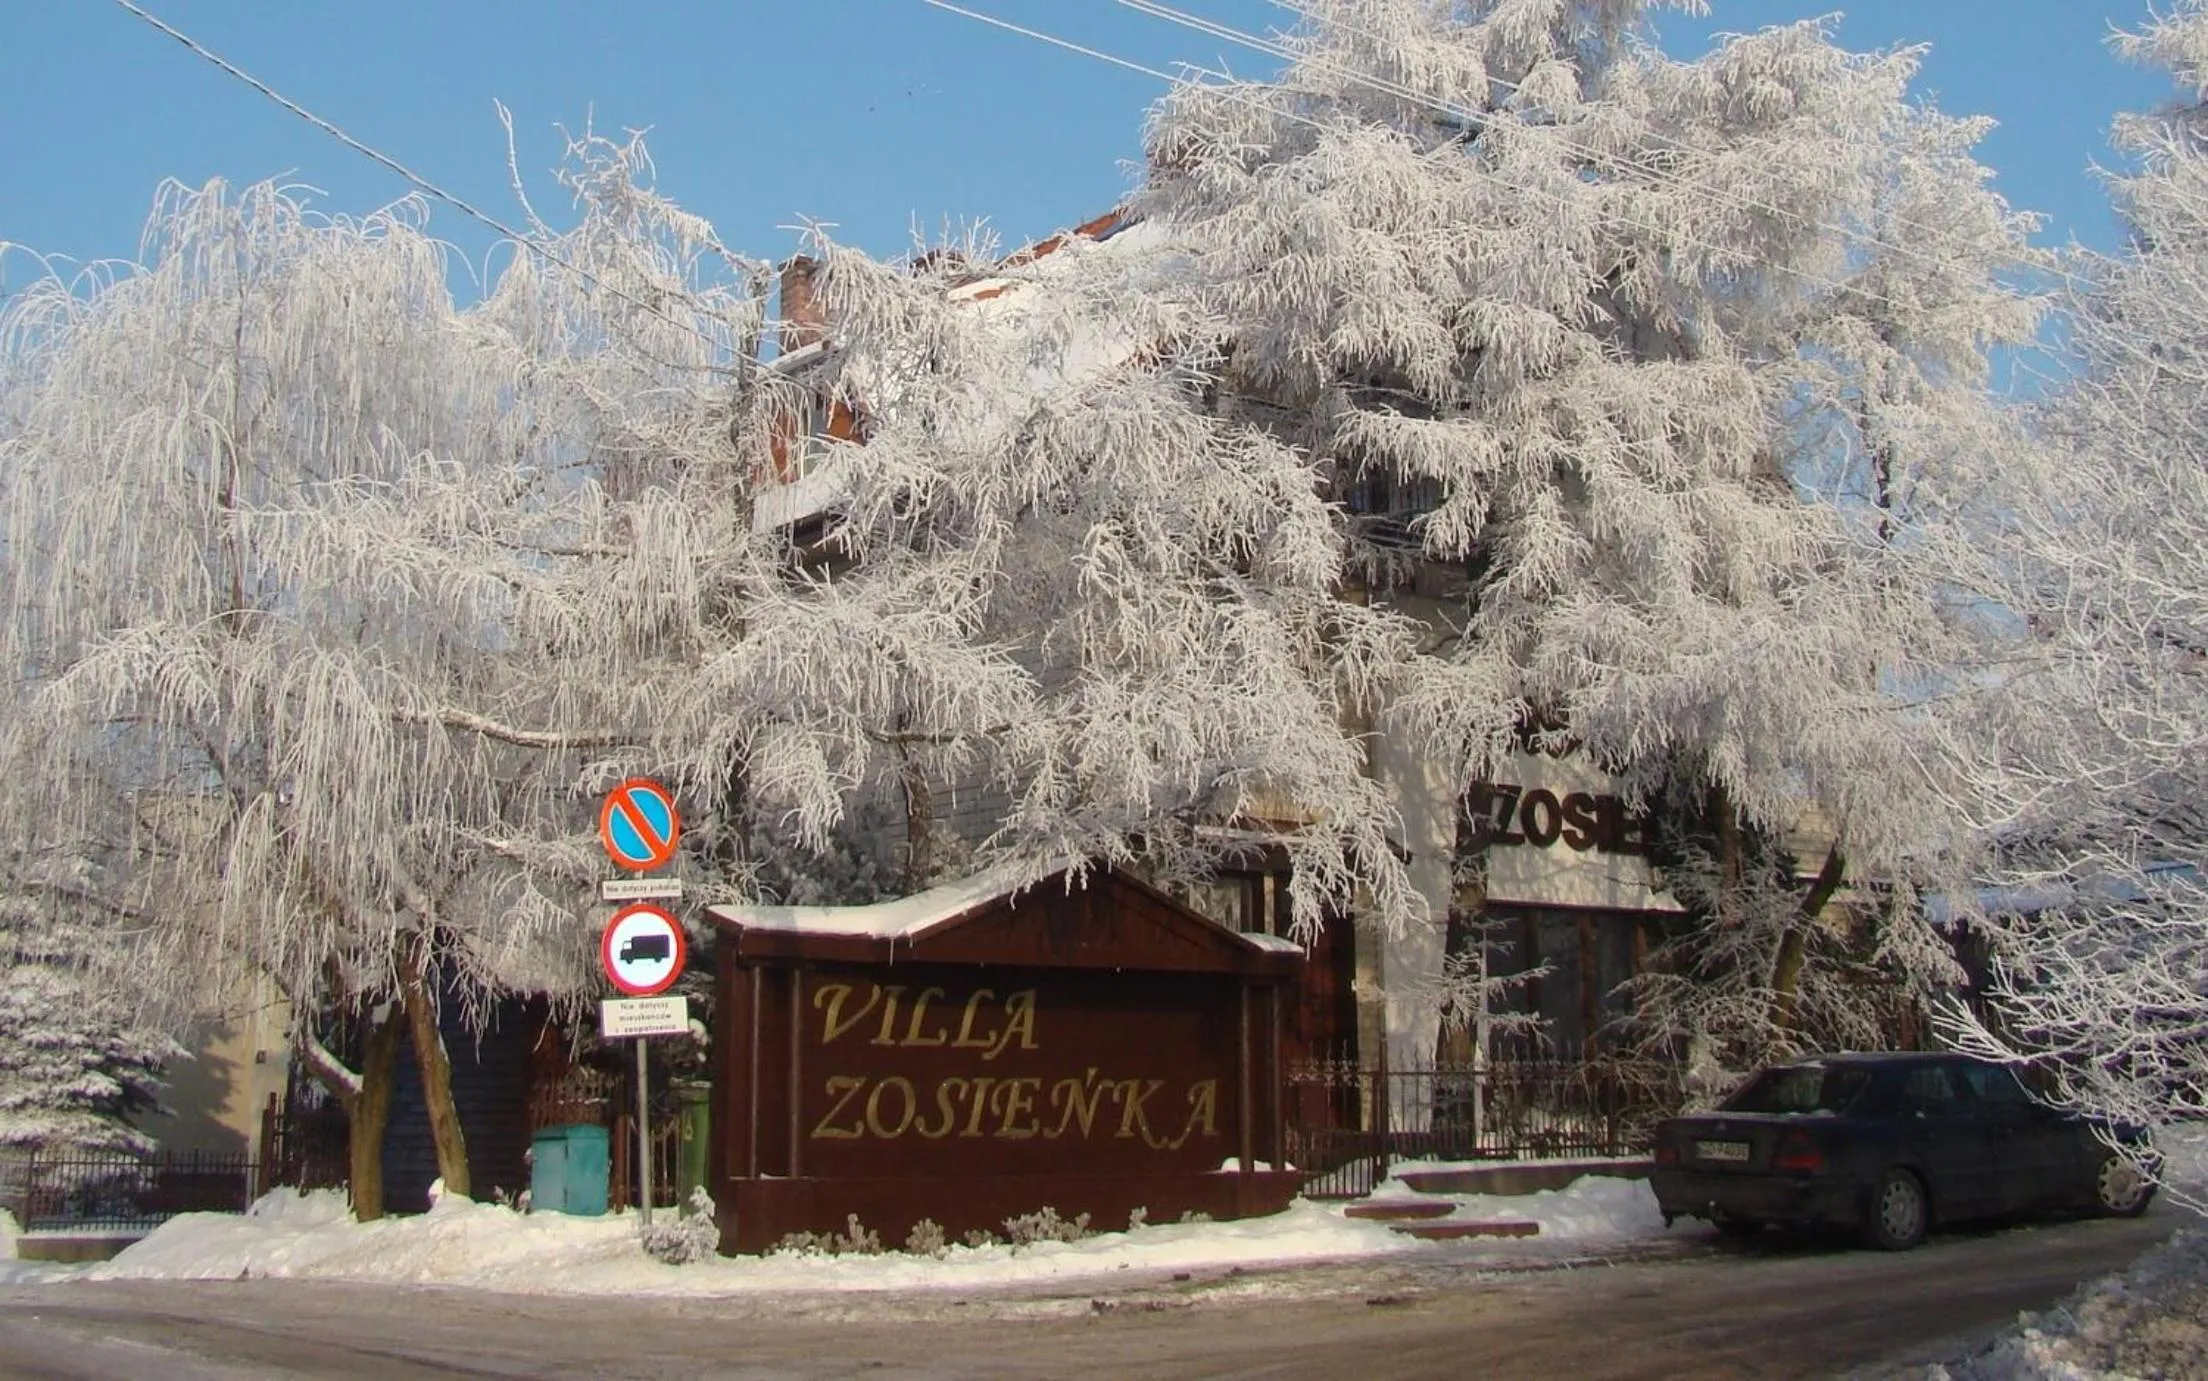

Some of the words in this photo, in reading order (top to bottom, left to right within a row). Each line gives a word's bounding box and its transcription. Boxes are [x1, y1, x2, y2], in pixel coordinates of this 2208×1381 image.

[638, 1001, 669, 1010] dotyczy
[814, 983, 1039, 1060] VILLA
[811, 1066, 1220, 1150] ZOSIEŃKA
